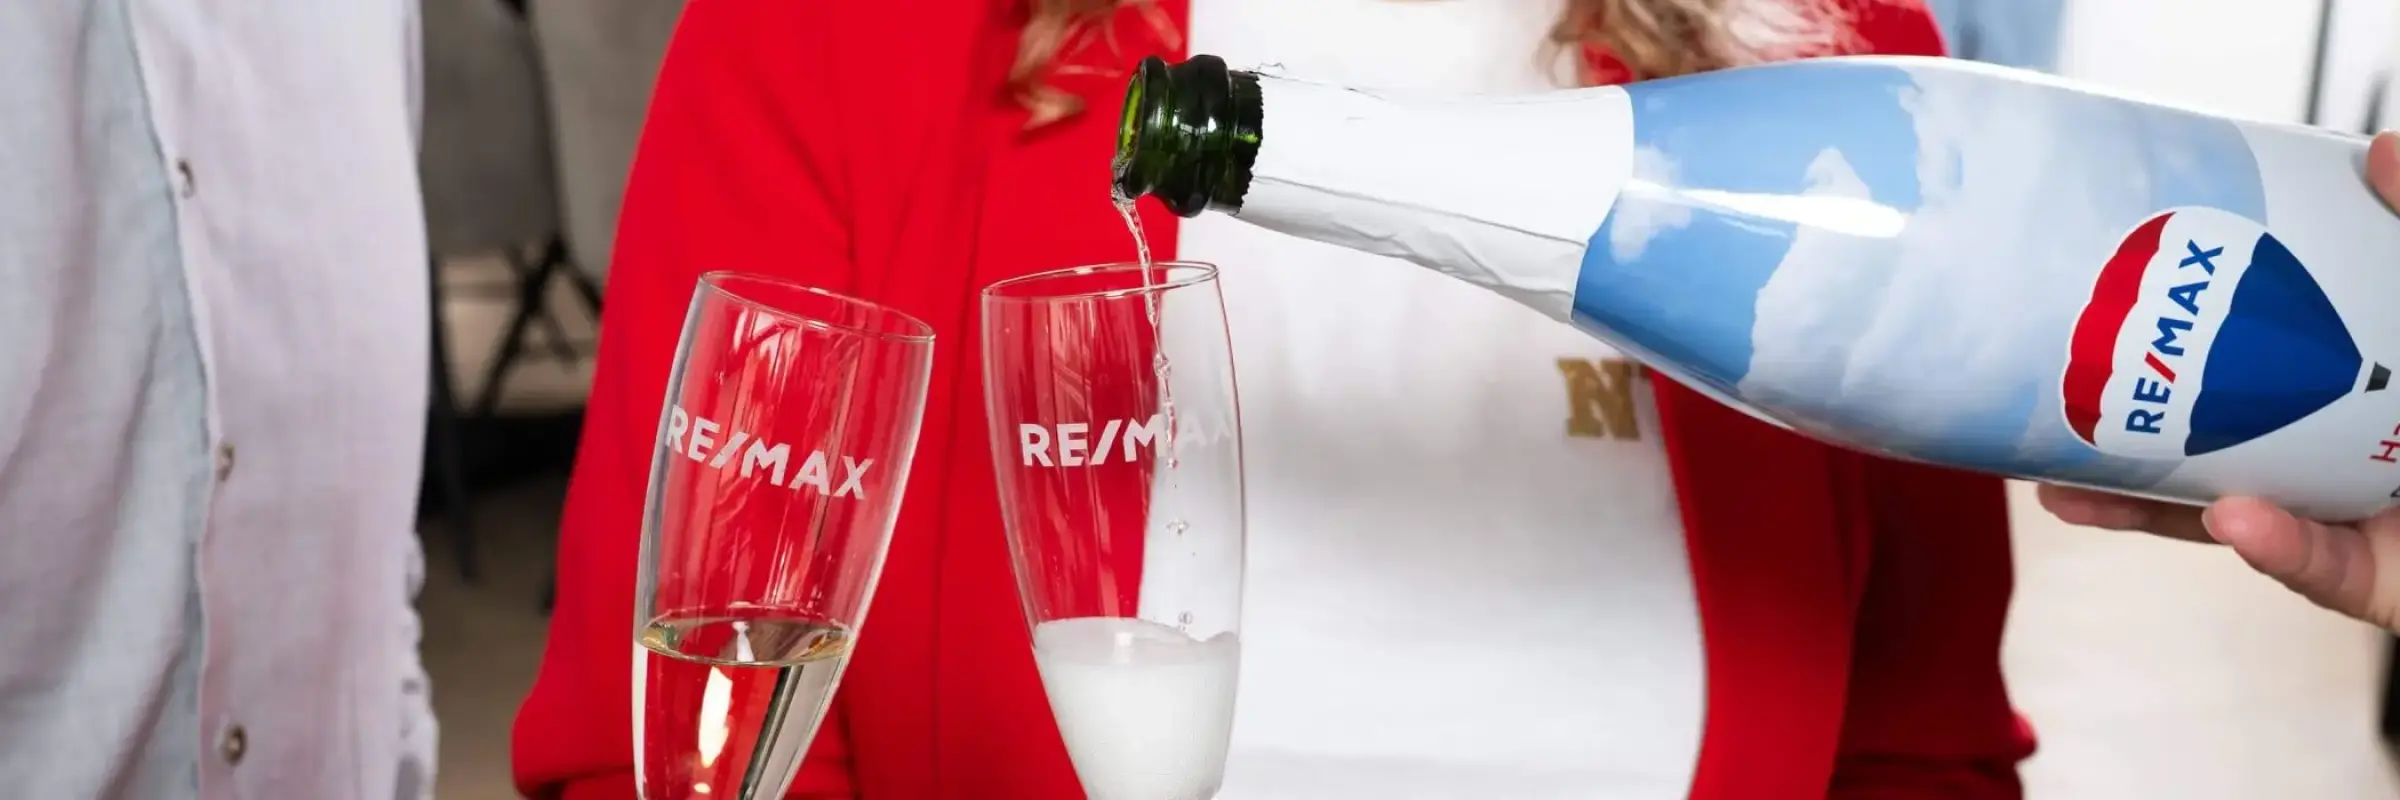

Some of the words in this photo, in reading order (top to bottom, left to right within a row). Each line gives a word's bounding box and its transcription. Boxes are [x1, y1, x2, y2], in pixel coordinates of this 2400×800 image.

[2125, 238, 2225, 435] RE/MAX
[665, 403, 874, 500] RE/MAX
[1019, 409, 1233, 468] RE/MAX
